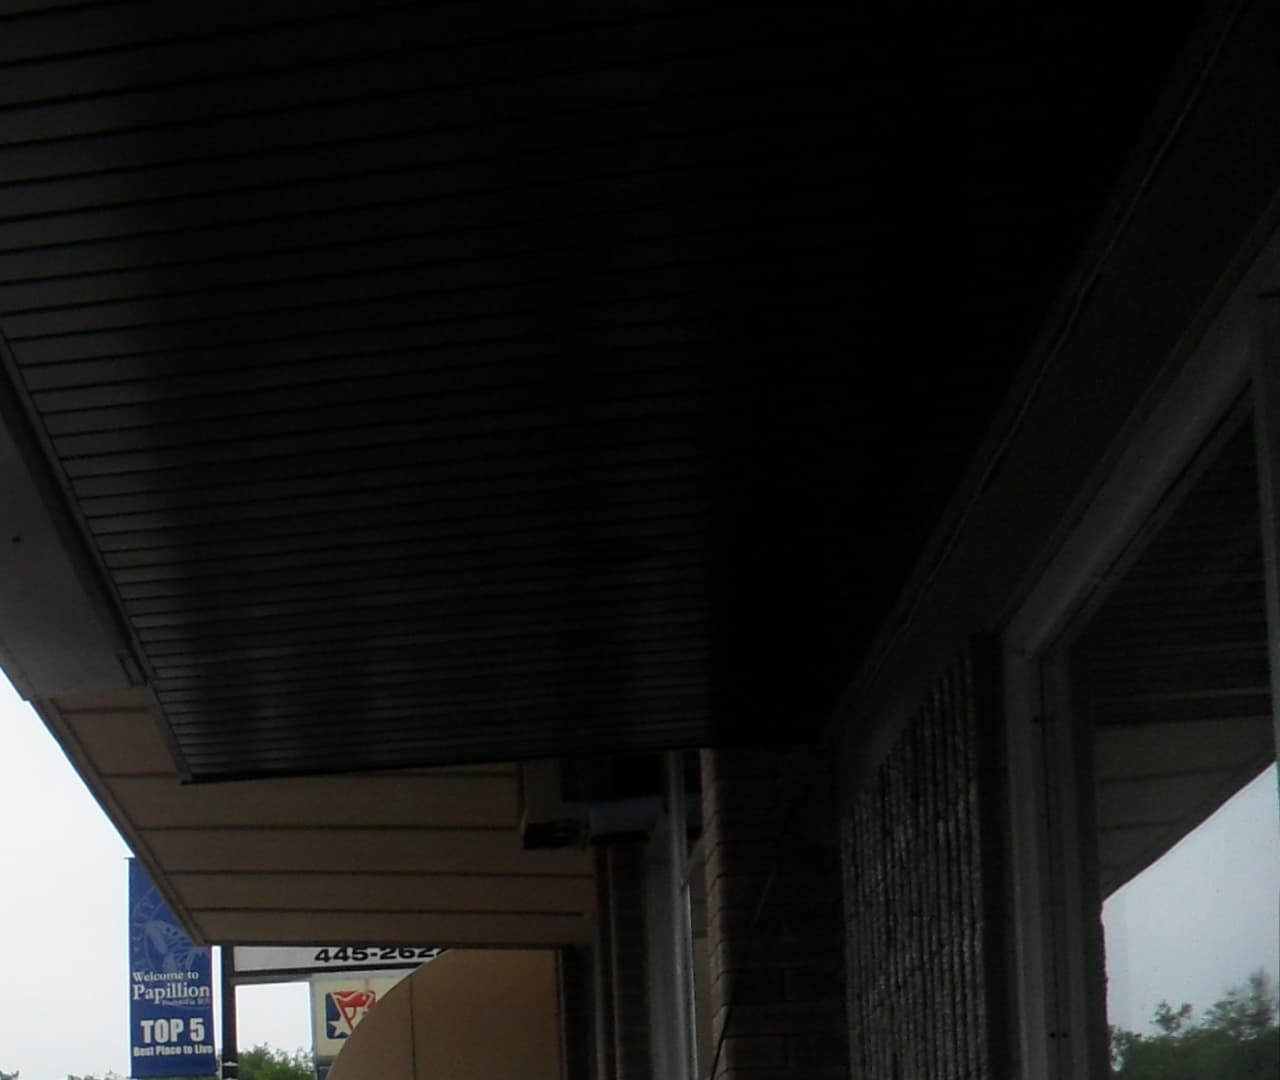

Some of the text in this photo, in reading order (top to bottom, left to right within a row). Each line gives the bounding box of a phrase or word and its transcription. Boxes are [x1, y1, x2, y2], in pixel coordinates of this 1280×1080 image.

[314, 947, 446, 963] 445-262
[132, 971, 199, 983] Welcome to
[132, 982, 210, 1005] Papillion
[140, 1017, 206, 1044] TOP 5
[133, 1044, 214, 1057] Best Place to Live
